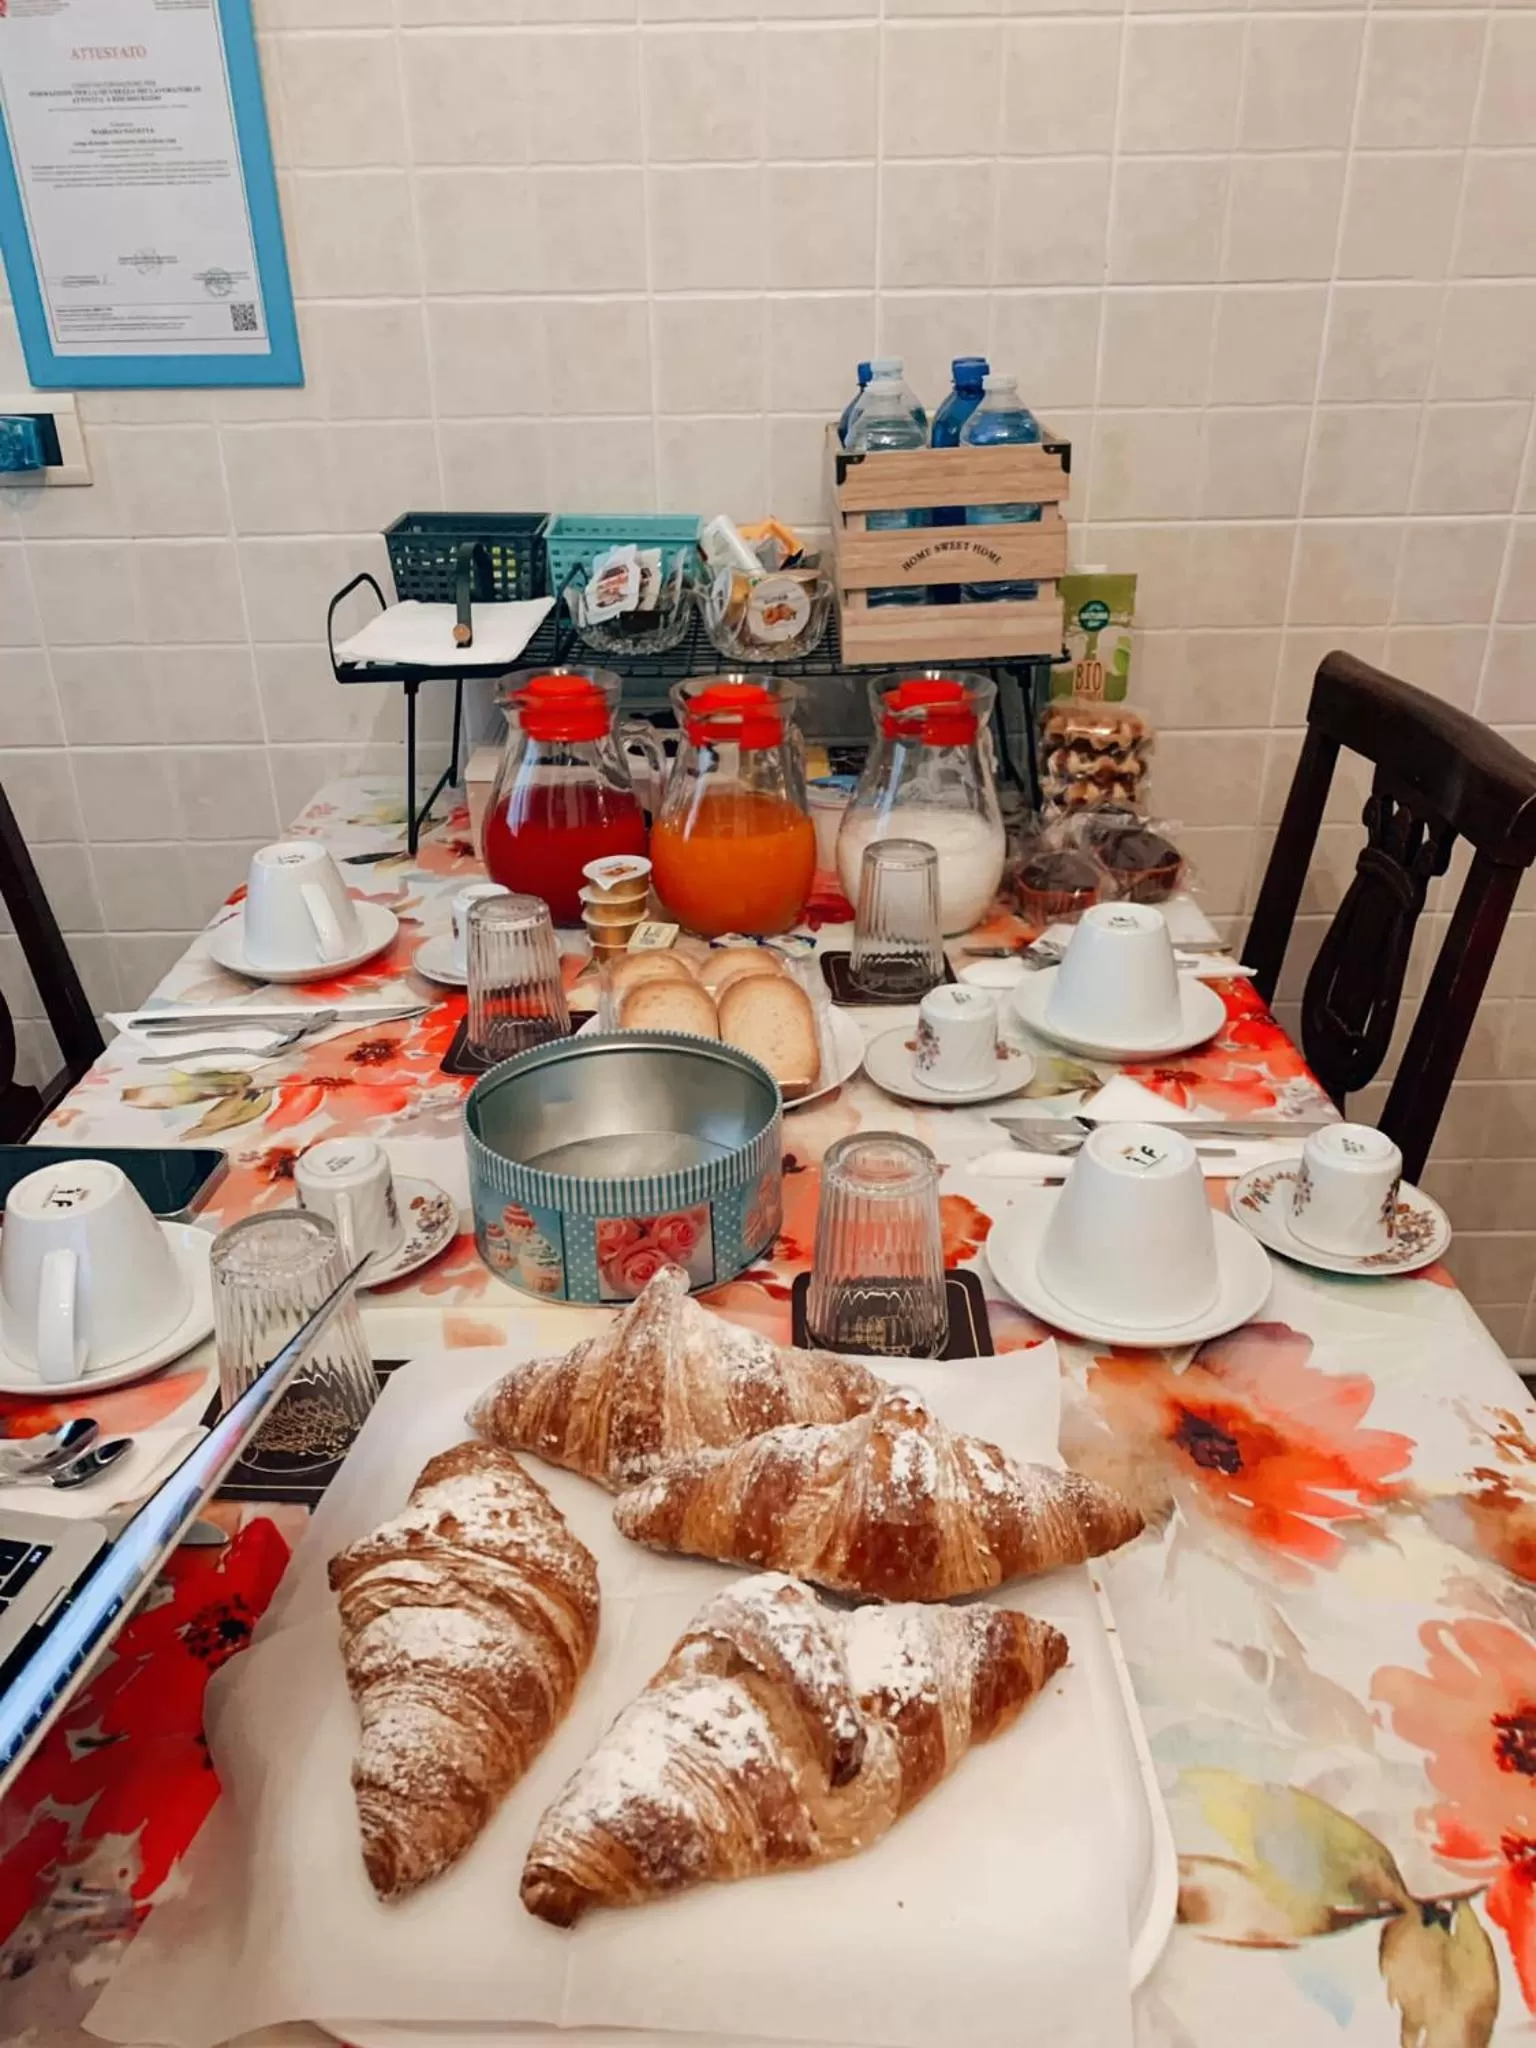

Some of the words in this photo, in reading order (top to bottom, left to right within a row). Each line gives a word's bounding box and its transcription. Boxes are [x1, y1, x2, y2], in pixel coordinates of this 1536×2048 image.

[70, 45, 148, 61] ATTESTATO
[901, 548, 931, 571] HOME
[934, 541, 969, 553] SWEET
[973, 544, 1003, 567] HOME
[1075, 661, 1103, 690] BIO
